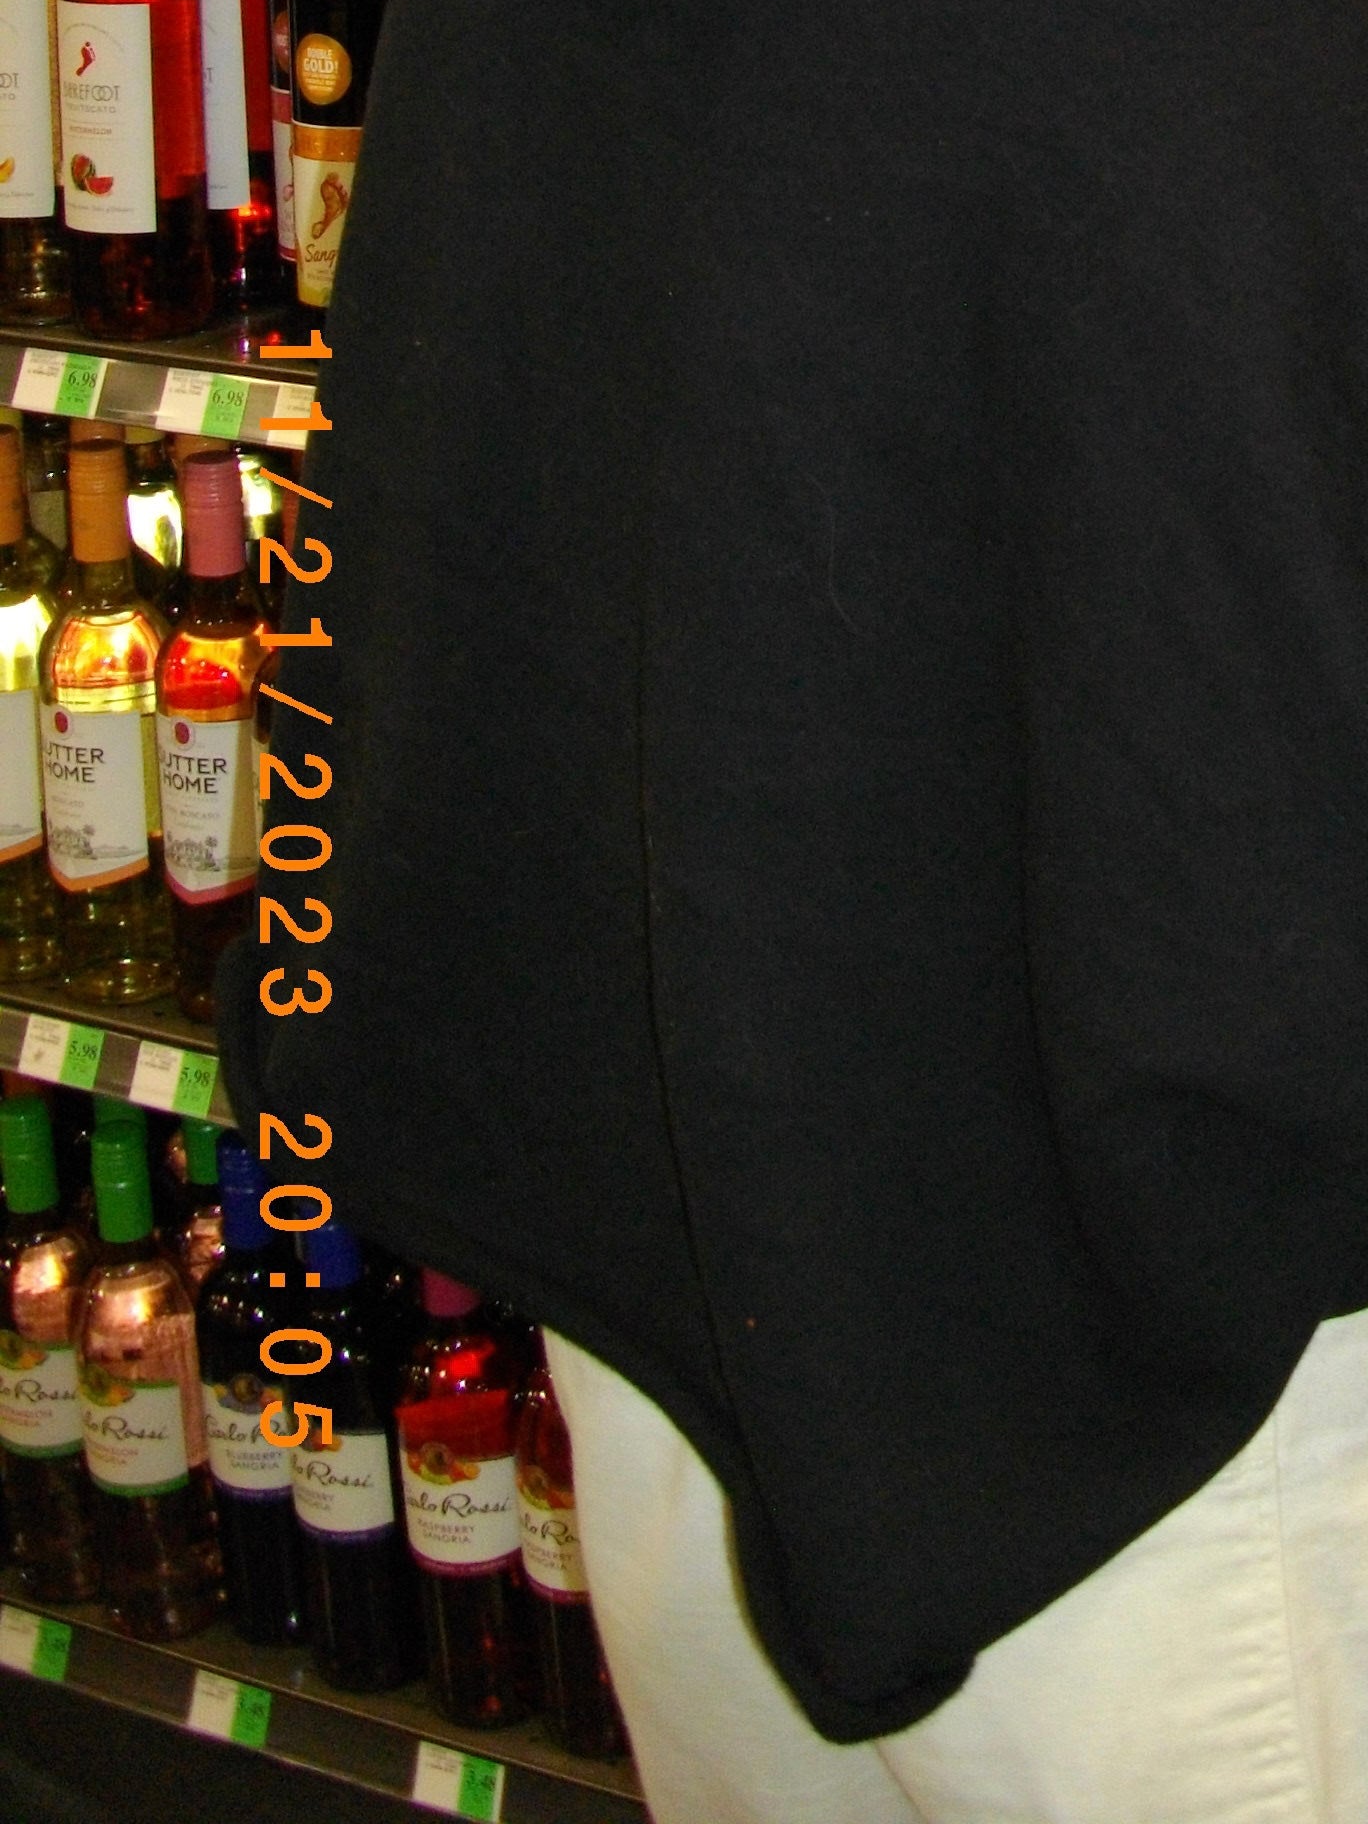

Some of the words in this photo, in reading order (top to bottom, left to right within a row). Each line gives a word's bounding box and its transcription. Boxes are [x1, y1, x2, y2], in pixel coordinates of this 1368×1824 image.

[68, 370, 98, 388] 6.98
[212, 389, 244, 407] 6.98
[163, 774, 217, 794] HOME
[69, 1041, 98, 1060] 5.98
[181, 1068, 211, 1088] 5.98
